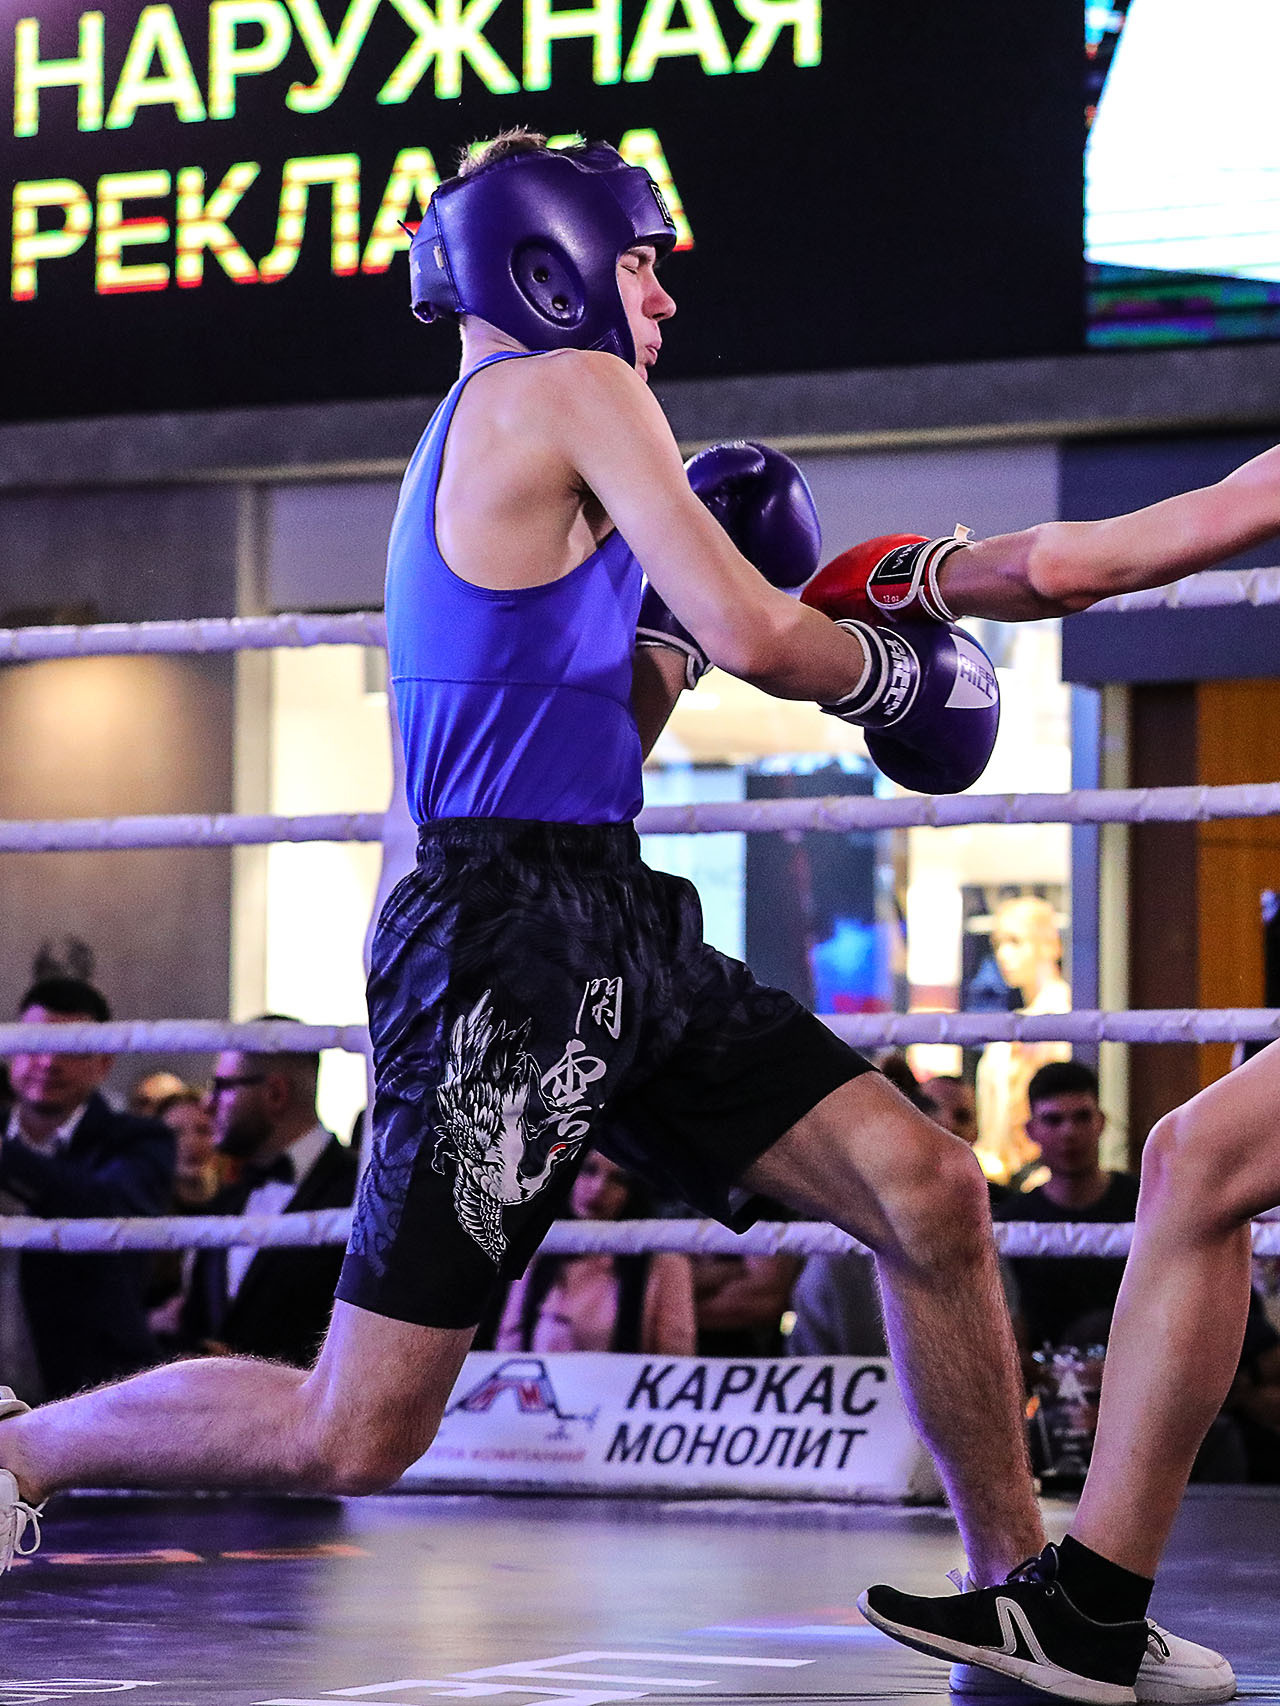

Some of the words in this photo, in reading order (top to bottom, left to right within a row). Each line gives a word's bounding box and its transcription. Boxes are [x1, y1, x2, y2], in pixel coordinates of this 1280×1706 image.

[13, 0, 822, 138] НАРУЖНАЯ
[11, 128, 694, 301] РЕКЛАА
[960, 665, 993, 700] HILL
[627, 1364, 886, 1416] КАРКАС
[605, 1423, 867, 1469] МОНОЛИТ
